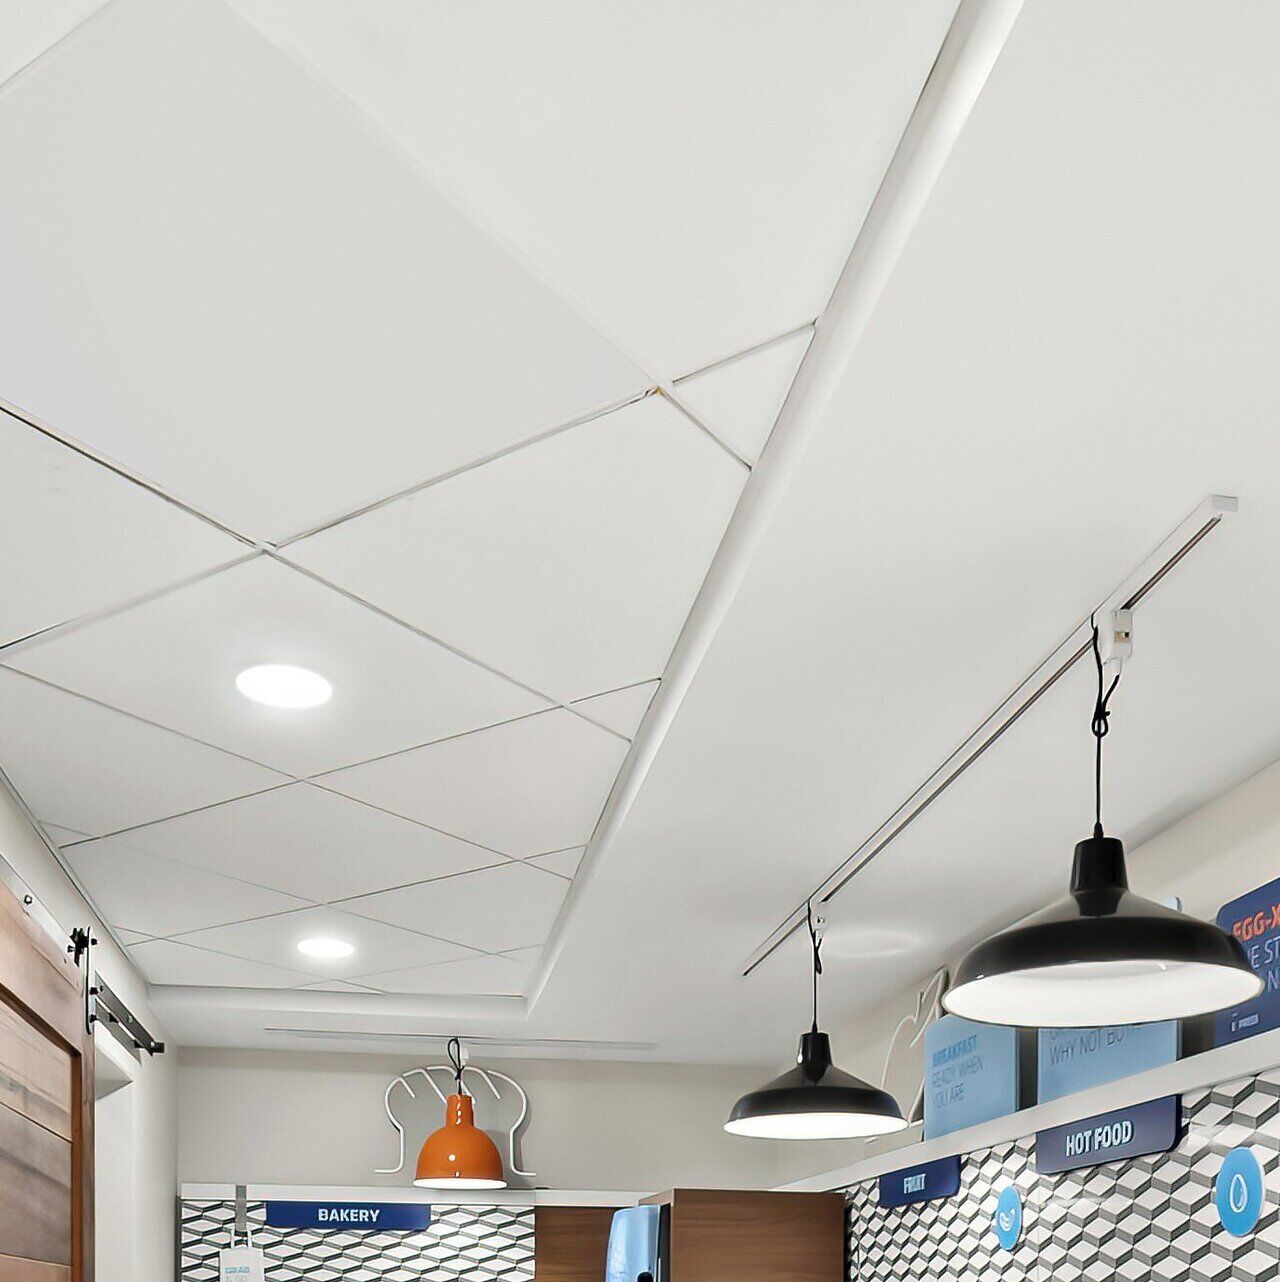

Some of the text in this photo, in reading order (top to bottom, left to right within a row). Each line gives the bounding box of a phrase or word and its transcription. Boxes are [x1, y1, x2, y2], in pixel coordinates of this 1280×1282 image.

[1050, 1038, 1077, 1066] WHY
[1080, 1028, 1102, 1055] NOT
[1066, 1120, 1133, 1157] HOT FOOD
[318, 1208, 381, 1223] BAKERY
